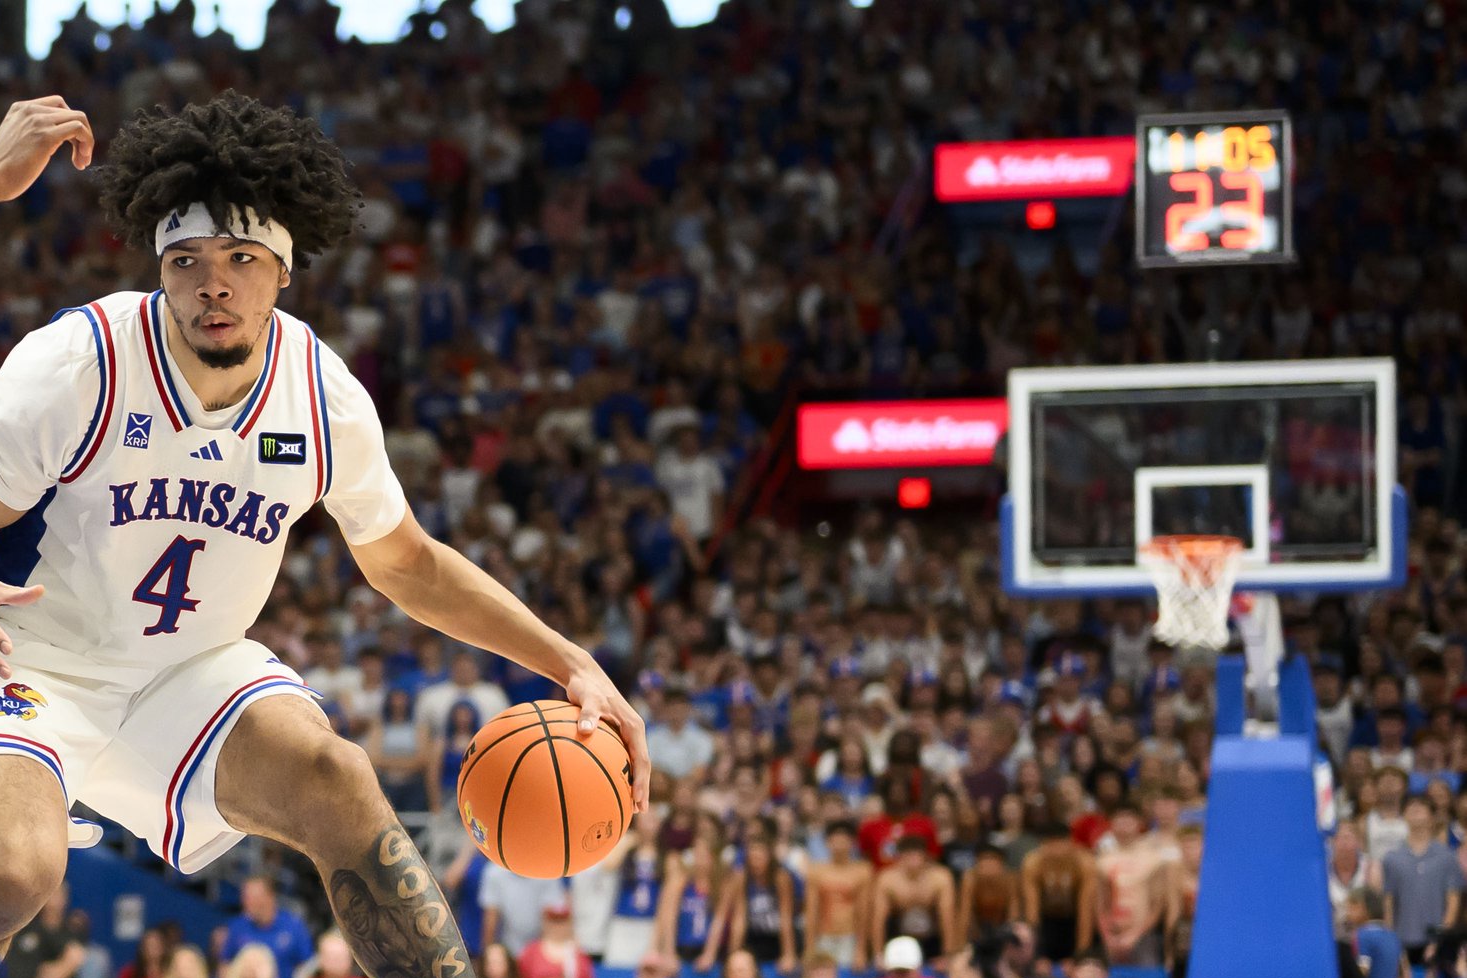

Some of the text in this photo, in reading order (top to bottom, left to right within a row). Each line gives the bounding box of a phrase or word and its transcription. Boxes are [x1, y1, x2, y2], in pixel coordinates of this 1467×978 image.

[1165, 172, 1265, 252] 23
[125, 436, 148, 448] XRP
[108, 477, 291, 545] KANSAS
[132, 534, 207, 636] 4
[2, 700, 20, 709] KU
